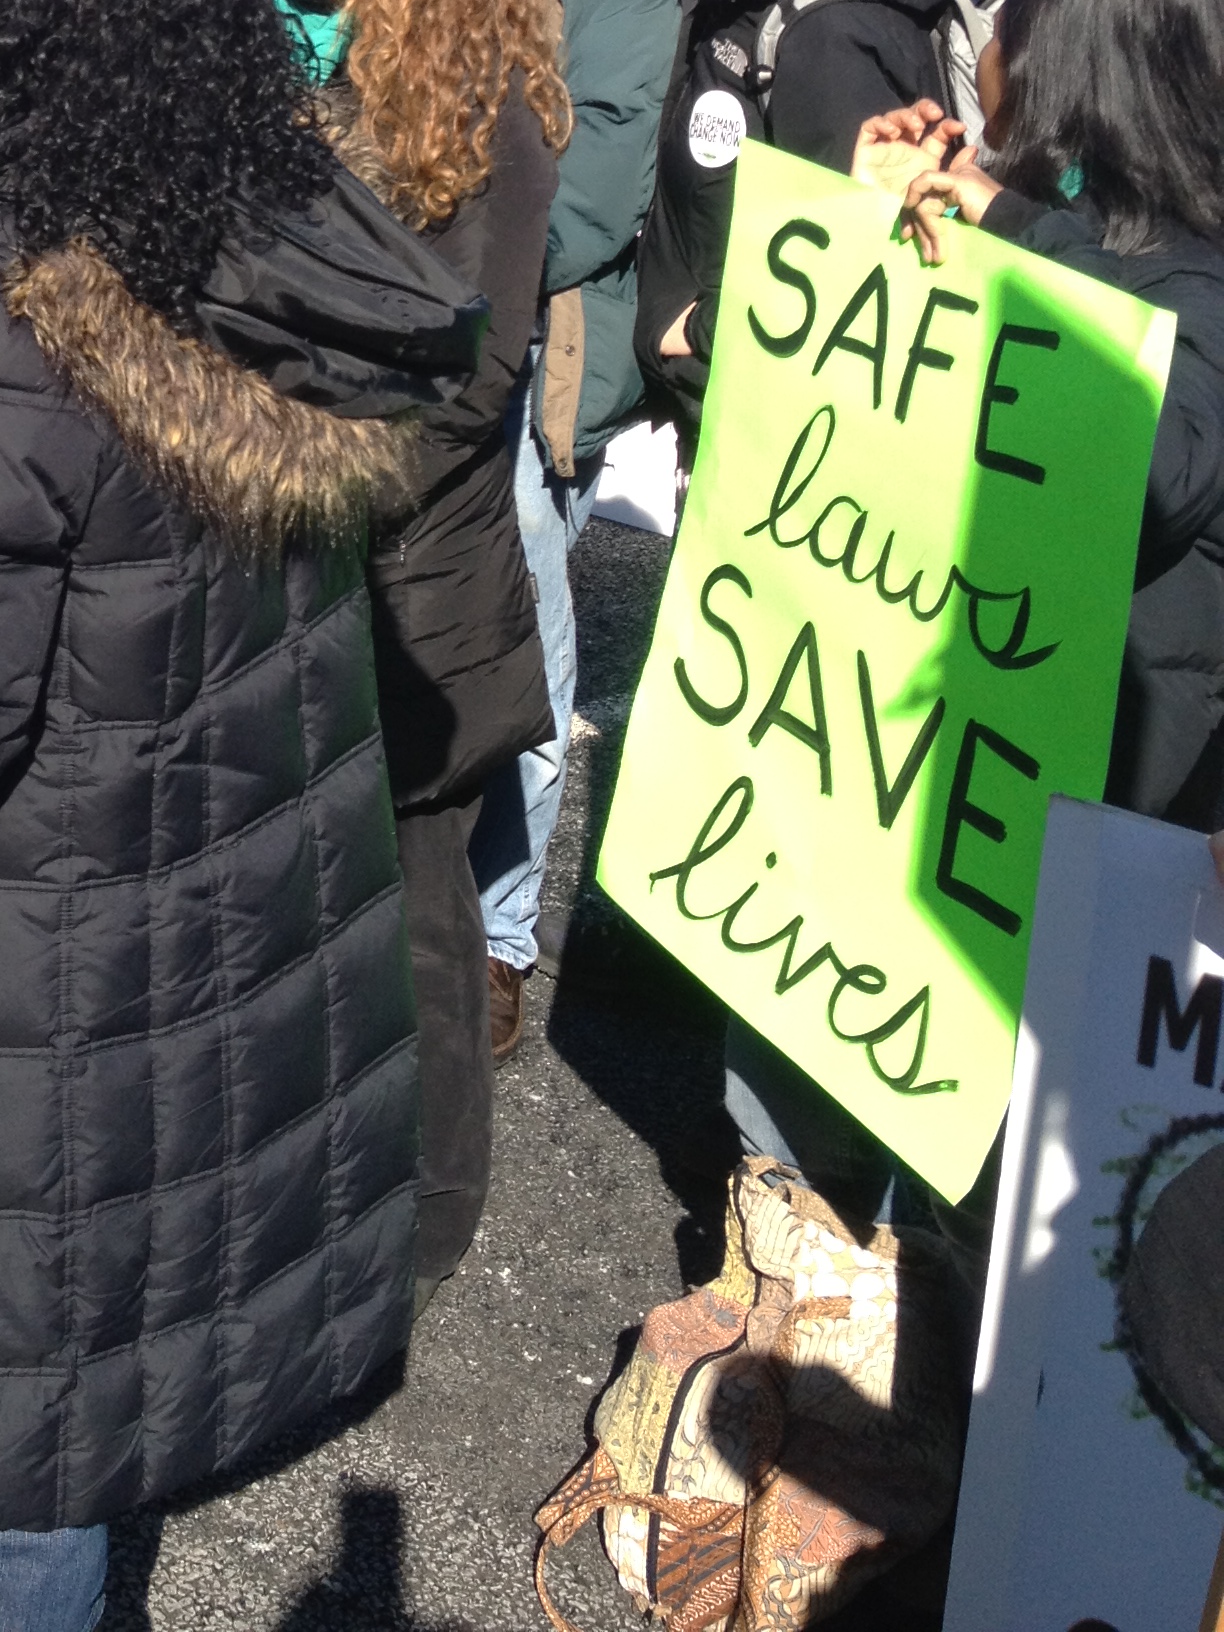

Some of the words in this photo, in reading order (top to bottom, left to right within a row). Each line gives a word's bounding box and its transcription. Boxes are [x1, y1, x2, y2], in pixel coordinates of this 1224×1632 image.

[706, 115, 741, 133] DEMAND
[719, 130, 740, 148] NOW
[747, 219, 1060, 485] SAFE
[744, 405, 1062, 669] laws
[674, 564, 1041, 936] SAVE
[649, 775, 959, 1096] lives
